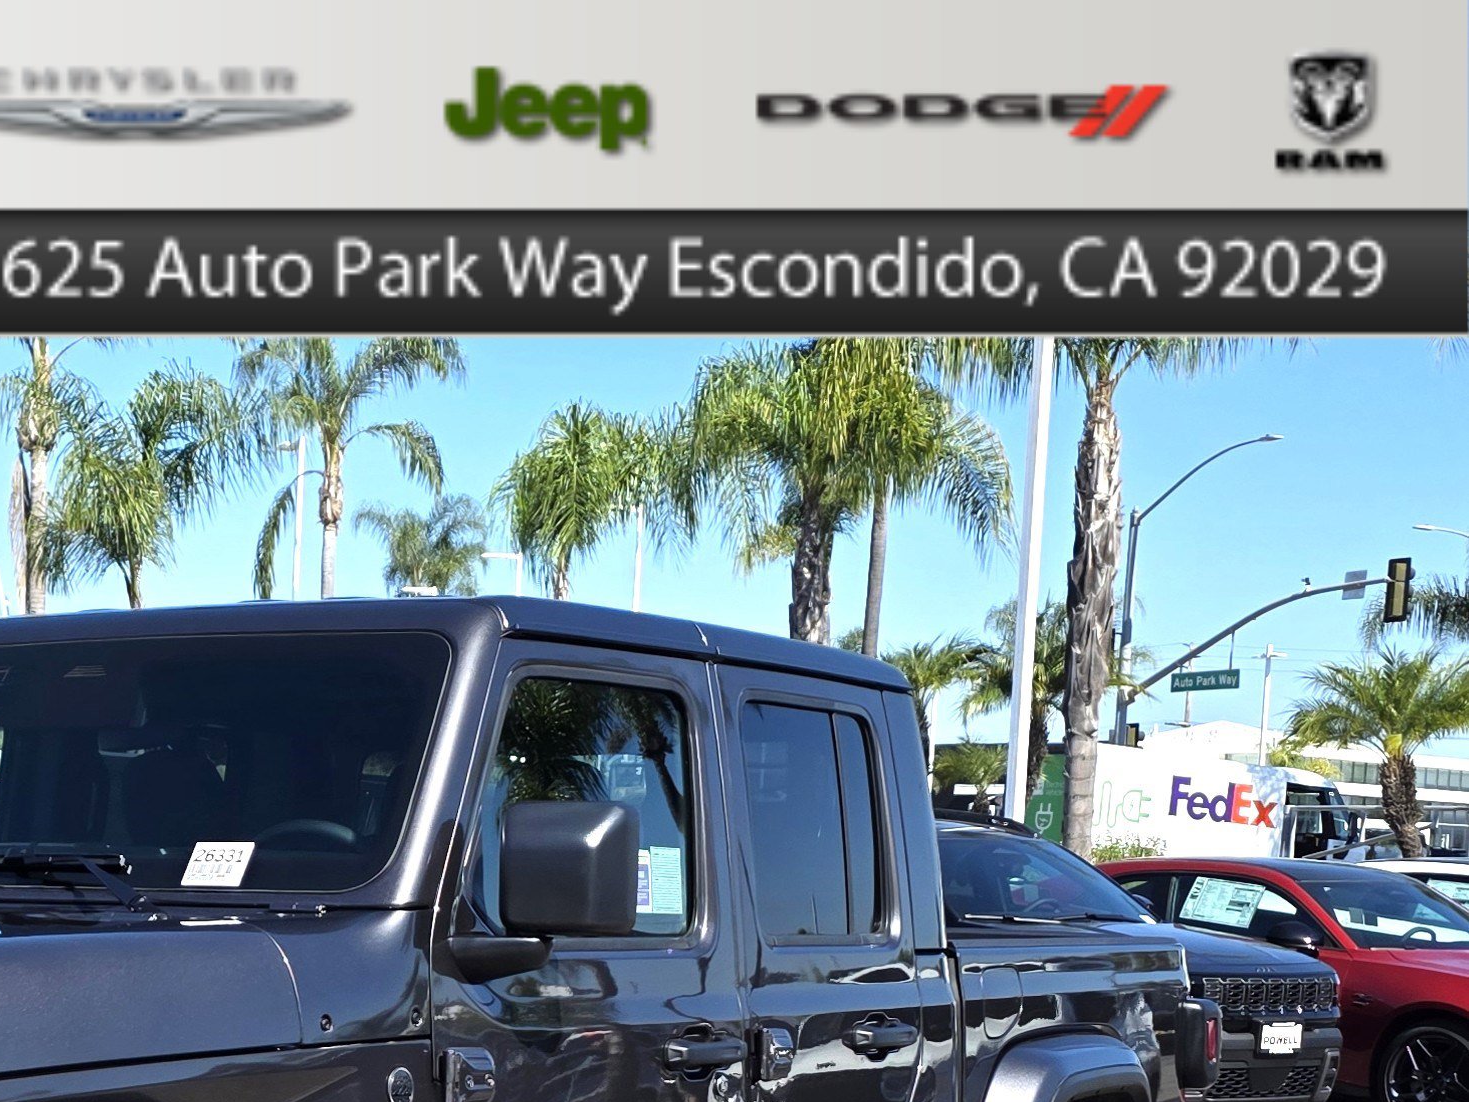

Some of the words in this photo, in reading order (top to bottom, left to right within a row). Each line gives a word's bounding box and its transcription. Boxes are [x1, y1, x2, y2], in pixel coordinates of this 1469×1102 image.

[1173, 677, 1193, 688] Auto
[1196, 675, 1216, 686] Park
[1219, 673, 1237, 686] Way
[1168, 775, 1277, 829] FedEx
[193, 849, 244, 863] 26331
